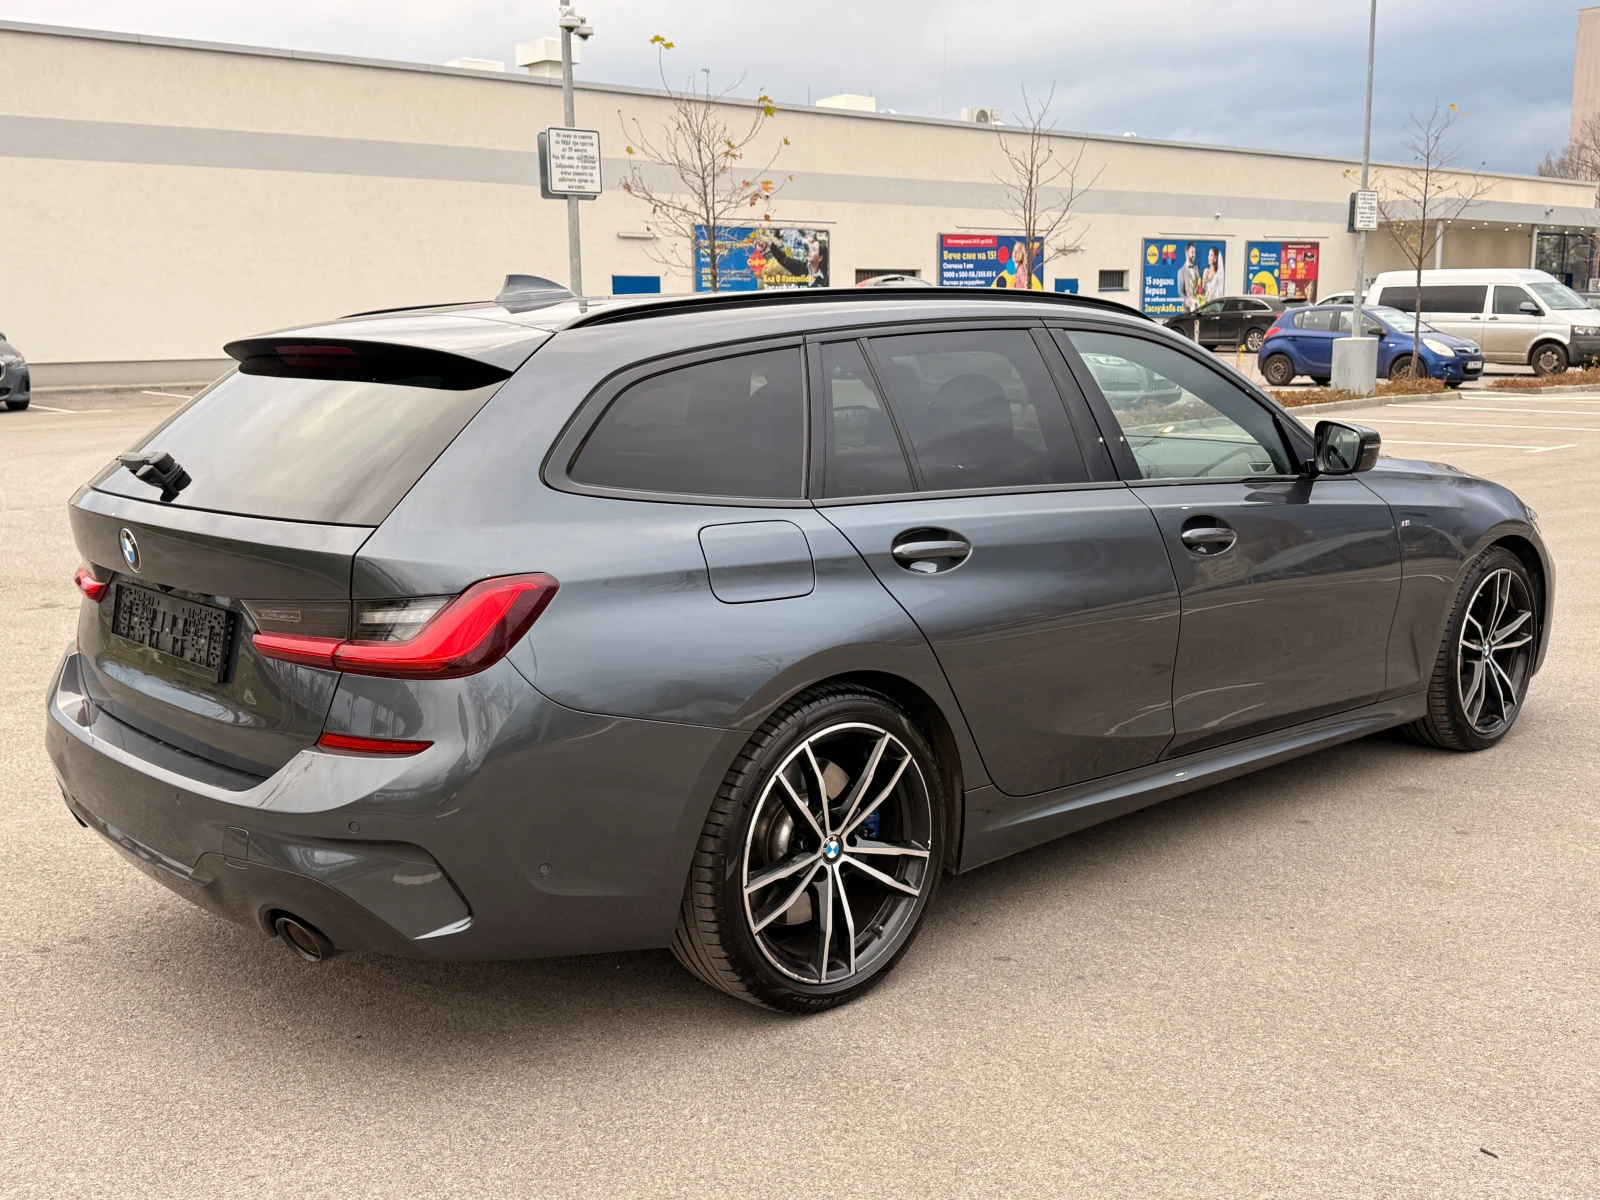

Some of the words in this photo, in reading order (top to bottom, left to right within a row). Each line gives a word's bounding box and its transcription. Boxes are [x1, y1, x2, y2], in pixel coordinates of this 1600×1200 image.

[943, 250, 961, 260] Вече
[987, 251, 996, 260] 15!
[1146, 276, 1152, 285] 15
[1153, 278, 1174, 287] години
[1145, 287, 1166, 296] верига
